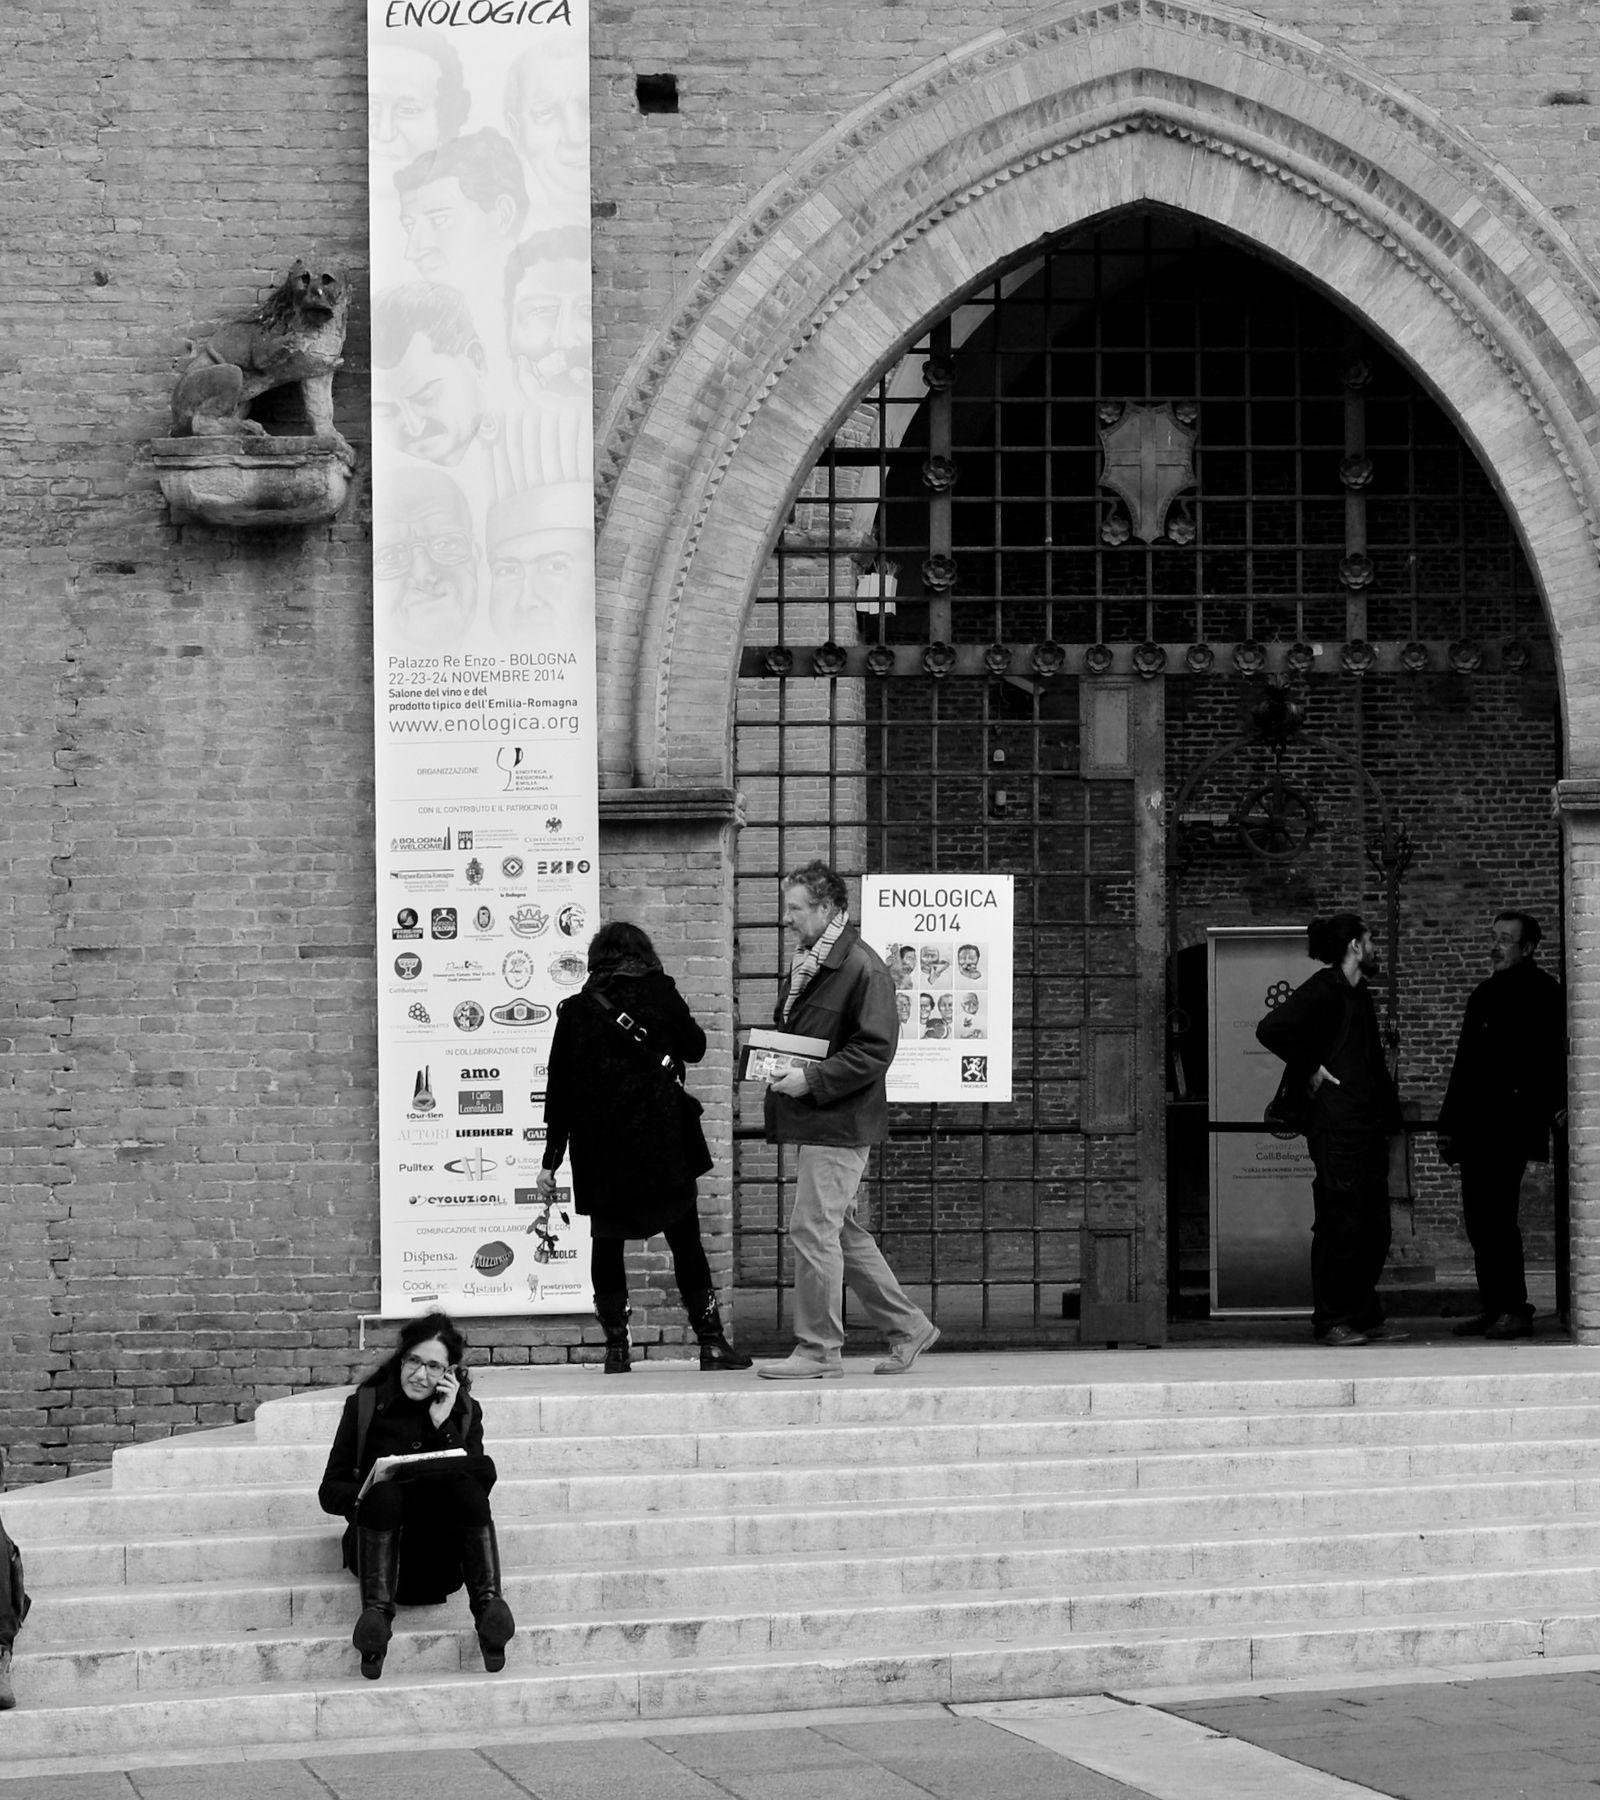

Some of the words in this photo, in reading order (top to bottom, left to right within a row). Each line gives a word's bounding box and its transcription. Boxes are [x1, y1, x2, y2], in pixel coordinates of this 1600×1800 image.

[386, 0, 572, 27] ENOLOGICA
[388, 656, 439, 669] Palazzo
[443, 655, 460, 668] Re
[464, 654, 496, 667] Enzo
[510, 652, 577, 666] BOLOGNA
[388, 671, 448, 685] 22-23-24
[452, 669, 530, 683] NOVEMBRE
[534, 668, 565, 682] 2014
[388, 688, 423, 698] Salone
[424, 687, 439, 697] del
[441, 687, 462, 697] vino
[472, 686, 487, 696] del
[389, 701, 431, 712] prodotto
[432, 700, 462, 711] tipico
[464, 698, 578, 709] dell'Emilia-Romagna
[389, 713, 579, 735] www.enologica.org
[416, 766, 479, 776] ORGANIZZAZIONE
[418, 806, 434, 814] CON
[443, 805, 490, 814] CONTRIBUTO
[399, 836, 443, 844] BOLOGNA
[879, 889, 998, 908] ENOLOGICA
[914, 913, 961, 932] 2014
[445, 1048, 454, 1056] IN
[455, 1047, 519, 1056] COLLABORAZIONE
[521, 1046, 537, 1055] CON
[460, 1067, 500, 1079] amo
[455, 1128, 514, 1138] LIEBHERR
[398, 1163, 434, 1173] Pulltex
[416, 1227, 477, 1236] COMUNICAZIONE
[554, 1223, 571, 1232] CON
